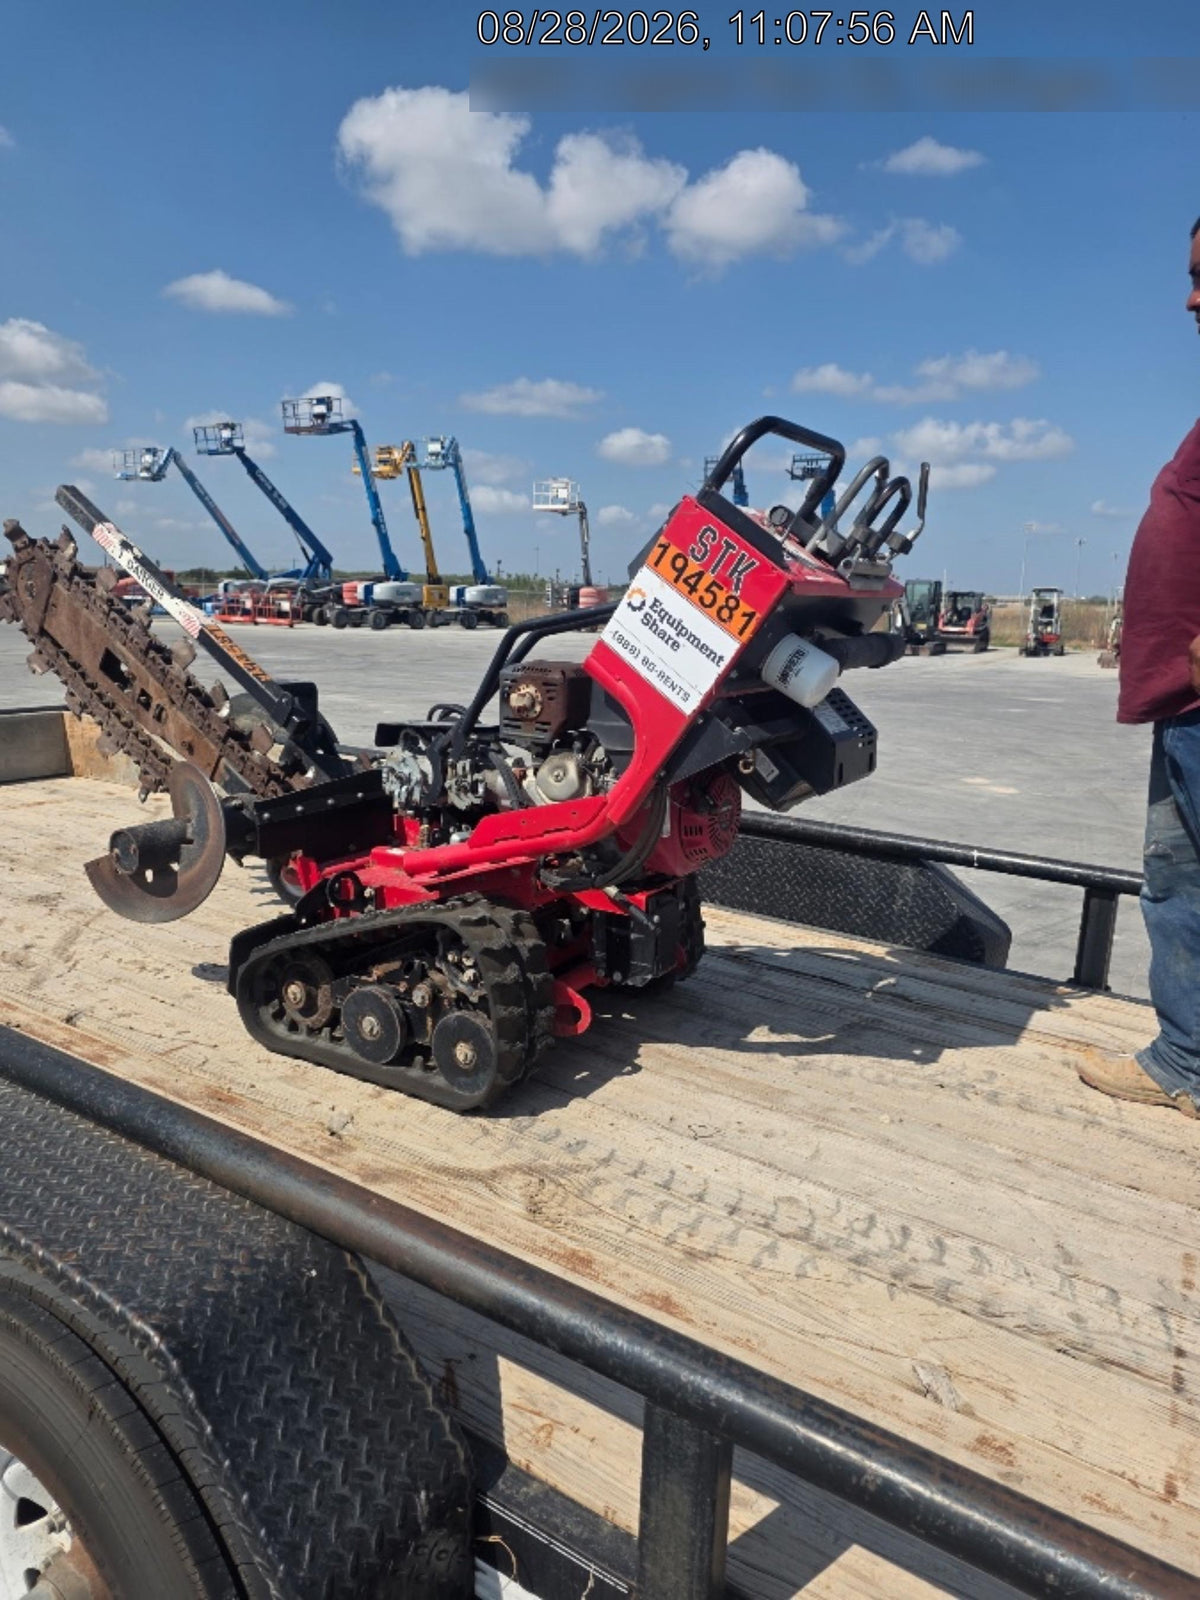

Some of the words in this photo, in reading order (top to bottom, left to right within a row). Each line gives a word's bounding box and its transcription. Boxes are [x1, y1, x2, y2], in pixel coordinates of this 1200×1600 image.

[654, 542, 757, 637] 194581
[689, 525, 760, 596] STK
[641, 612, 681, 652] Share
[648, 597, 725, 668] Equipment
